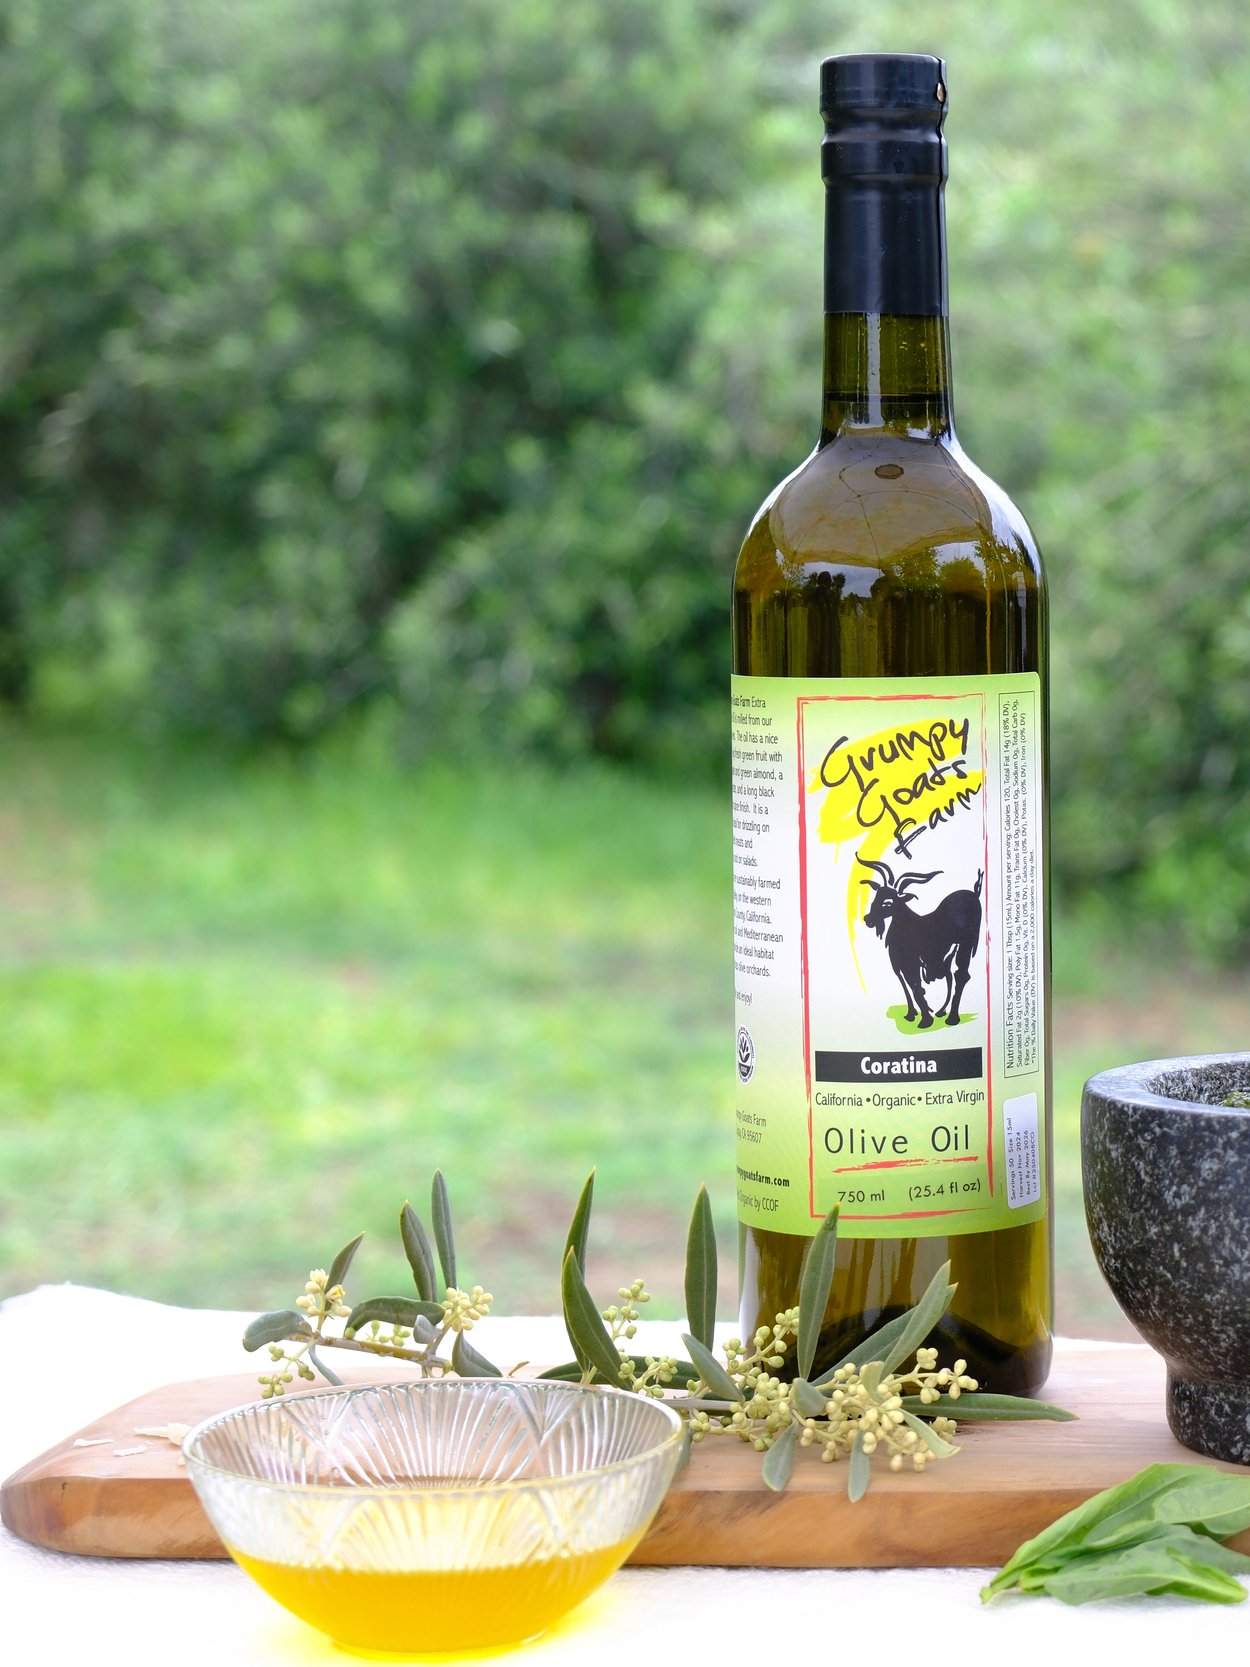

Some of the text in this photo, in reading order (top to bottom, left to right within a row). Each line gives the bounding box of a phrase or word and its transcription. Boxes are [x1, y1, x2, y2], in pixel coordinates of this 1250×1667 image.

[752, 696, 766, 708] Extra
[748, 714, 760, 725] from
[762, 718, 772, 726] our
[749, 732, 758, 743] has
[759, 735, 763, 744] a
[765, 733, 778, 744] nice
[742, 751, 754, 762] green
[756, 750, 767, 762] fruit
[769, 751, 782, 762] with
[820, 718, 969, 792] Grumpy
[741, 769, 752, 779] green
[753, 768, 776, 781] almond,
[779, 772, 783, 781] a
[747, 785, 757, 799] long
[759, 786, 775, 797] black
[856, 758, 968, 831] Goats
[753, 803, 757, 814] It
[758, 803, 763, 814] is
[764, 806, 768, 815] a
[742, 819, 760, 835] drizzling
[762, 824, 770, 832] on
[894, 783, 982, 859] Farm
[758, 876, 780, 889] farmed
[750, 896, 771, 906] western
[744, 927, 783, 942] Mediterranean
[743, 945, 753, 957] ideal
[754, 946, 774, 960] habitat
[747, 964, 770, 977] orchards.
[1006, 973, 1014, 999] Serving
[1016, 1011, 1022, 1019] 2g
[1006, 1029, 1014, 1068] Nutrition
[860, 1056, 937, 1074] Coratina
[816, 1092, 863, 1106] California
[925, 1092, 953, 1105] Extra
[956, 1089, 984, 1106] Virgin
[742, 1110, 753, 1124] Goats
[753, 1114, 766, 1127] Farm
[747, 1130, 762, 1143] 95607
[824, 1124, 968, 1154] Olive Oil
[1009, 1158, 1015, 1167] 50
[838, 1178, 981, 1202] 750 ml (25.4 fl oz)
[740, 1191, 753, 1207] Organic
[754, 1196, 761, 1212] by
[762, 1198, 779, 1212] CCOF
